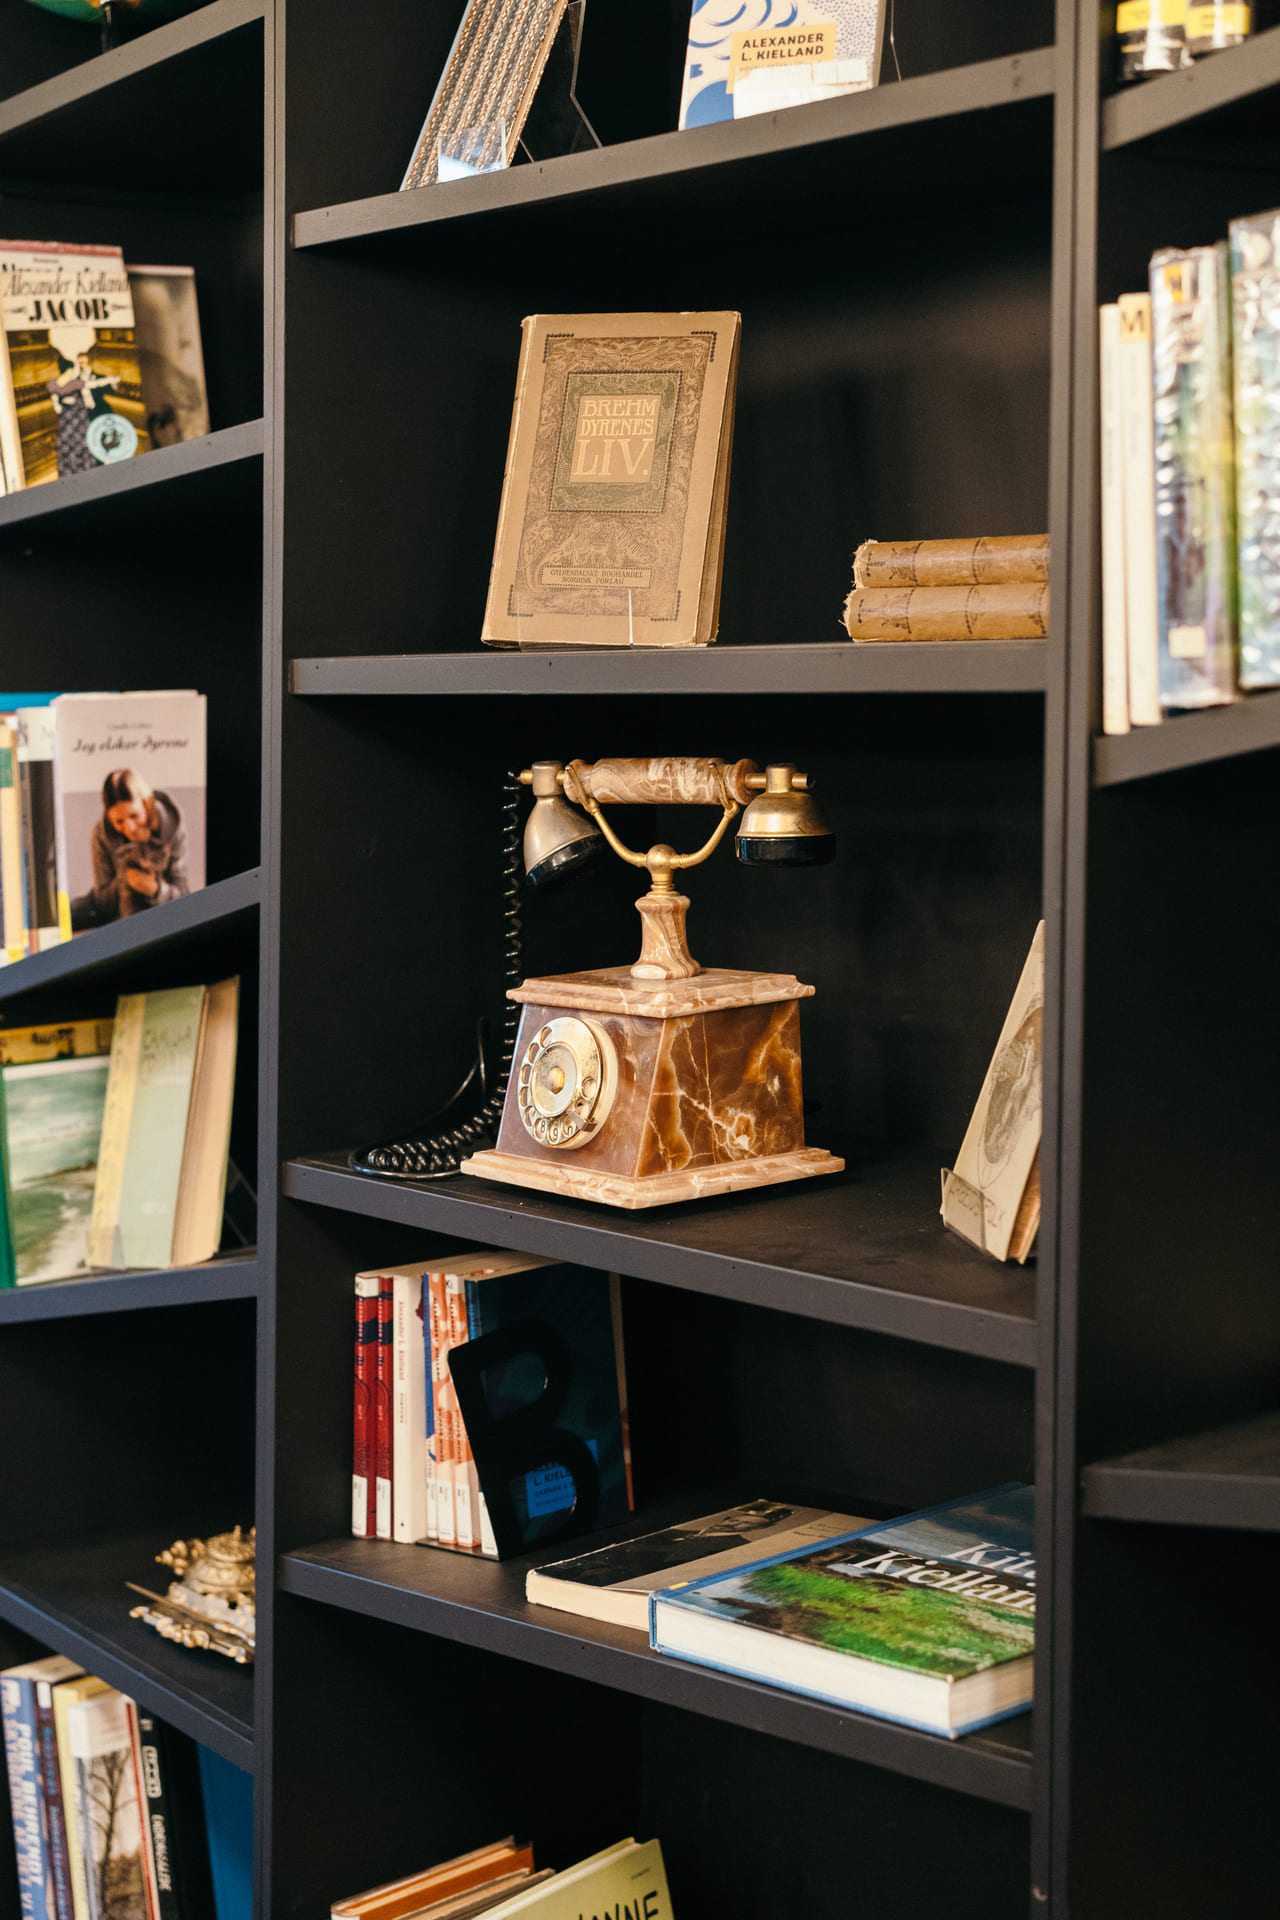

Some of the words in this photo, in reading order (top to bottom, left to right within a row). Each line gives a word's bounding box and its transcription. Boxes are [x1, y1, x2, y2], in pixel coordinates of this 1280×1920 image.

[742, 32, 825, 49] ALEXANDER
[741, 51, 753, 62] L.
[756, 45, 824, 61] KIELLAND
[29, 299, 109, 321] JACOB
[582, 399, 658, 417] BREHM
[579, 418, 655, 436] DYRENES
[561, 576, 592, 584] NORDISK
[847, 1550, 1036, 1611] Kiellan
